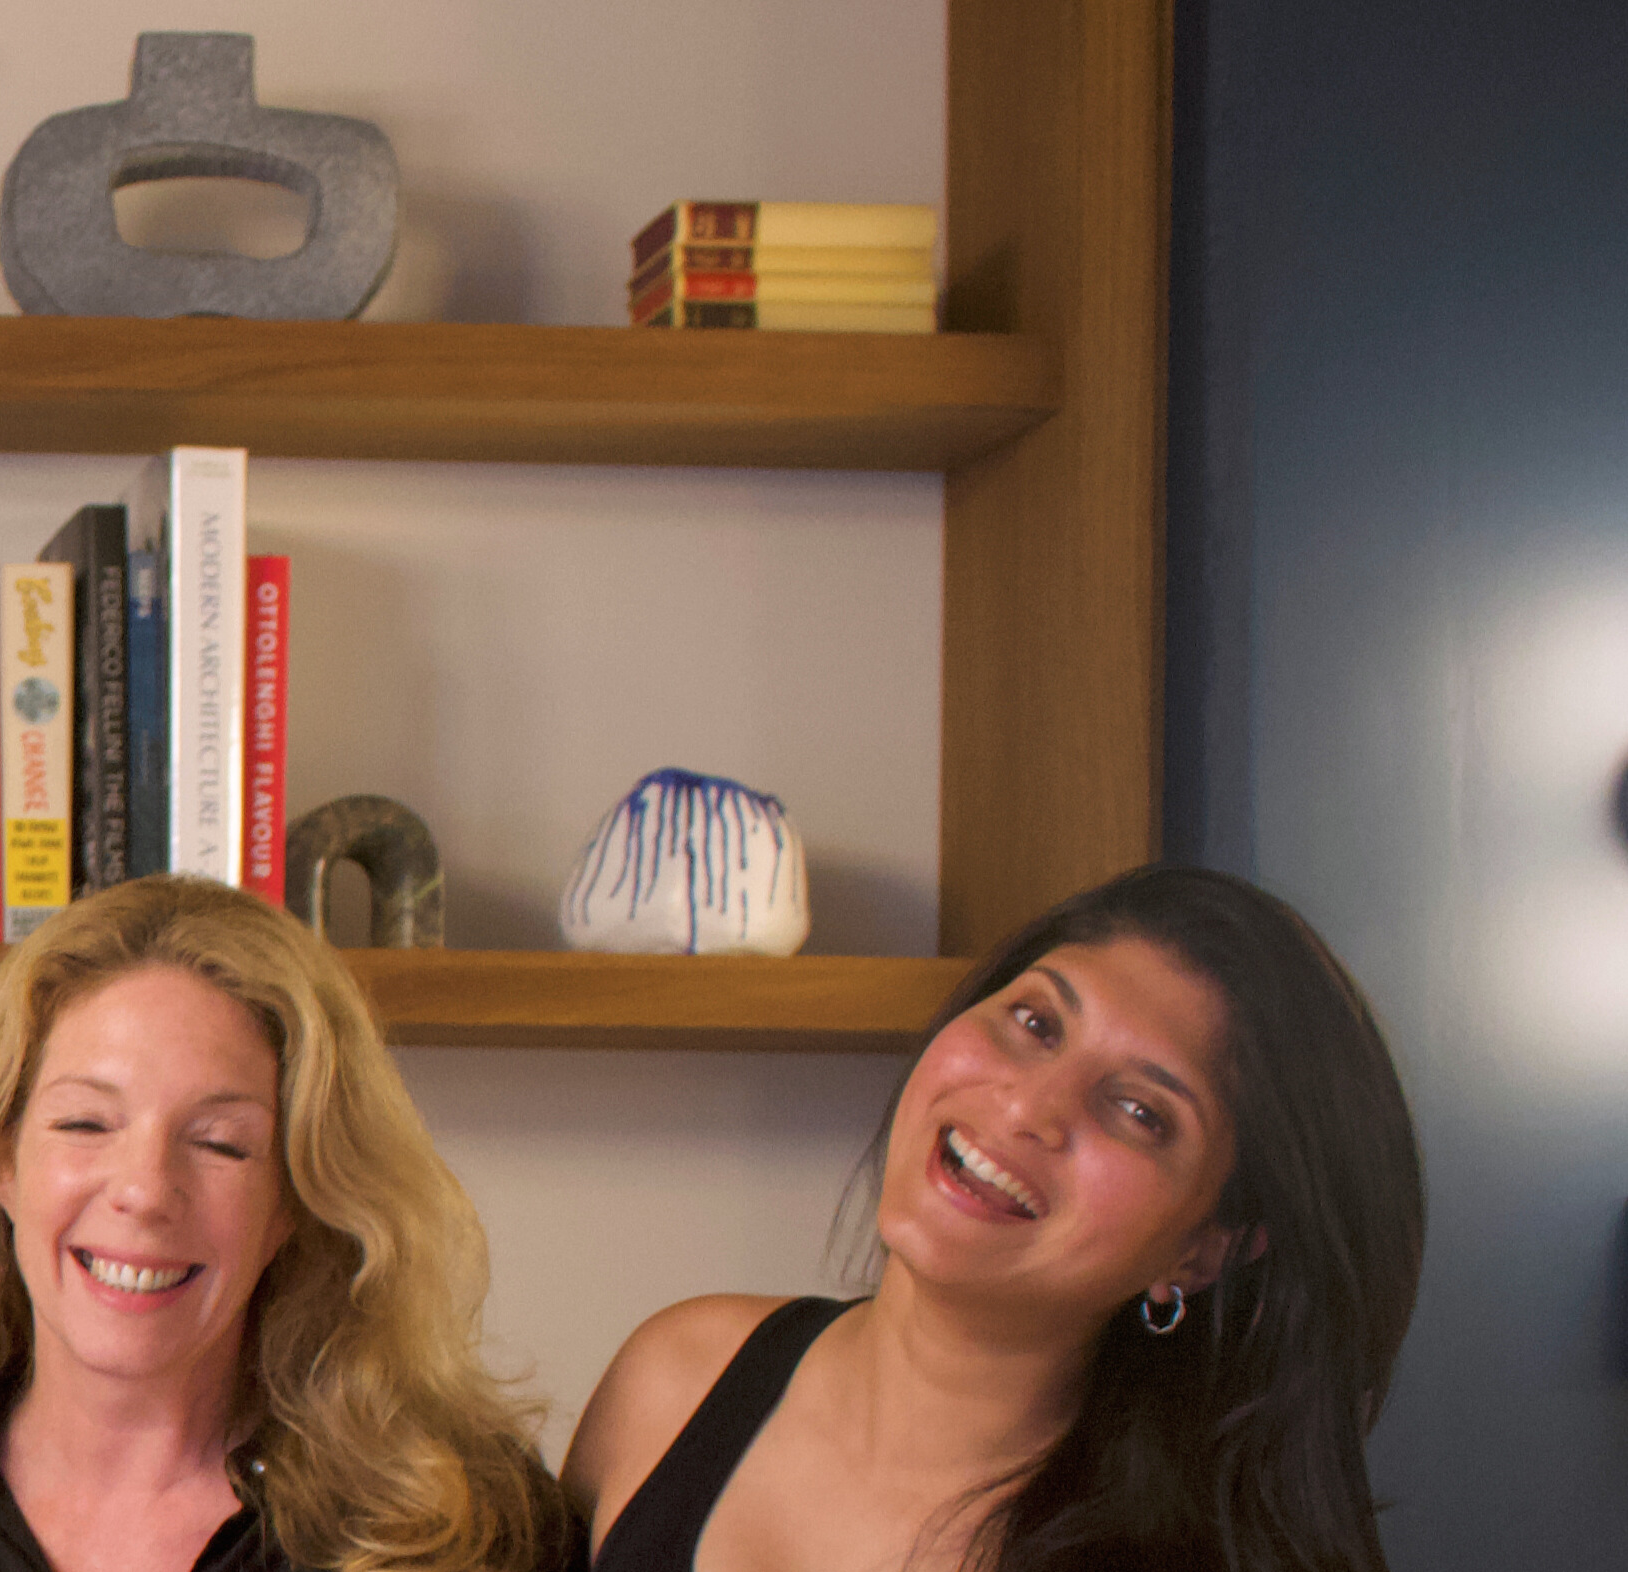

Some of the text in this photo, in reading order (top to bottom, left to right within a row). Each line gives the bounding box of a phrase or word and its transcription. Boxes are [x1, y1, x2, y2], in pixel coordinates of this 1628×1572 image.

[102, 566, 123, 676] FEDERICO
[200, 511, 221, 628] MODERN
[101, 680, 123, 761] FELLINI
[199, 640, 221, 826] ARCHITECTURE
[251, 583, 279, 879] OTTOLENGHI FLAVOUR
